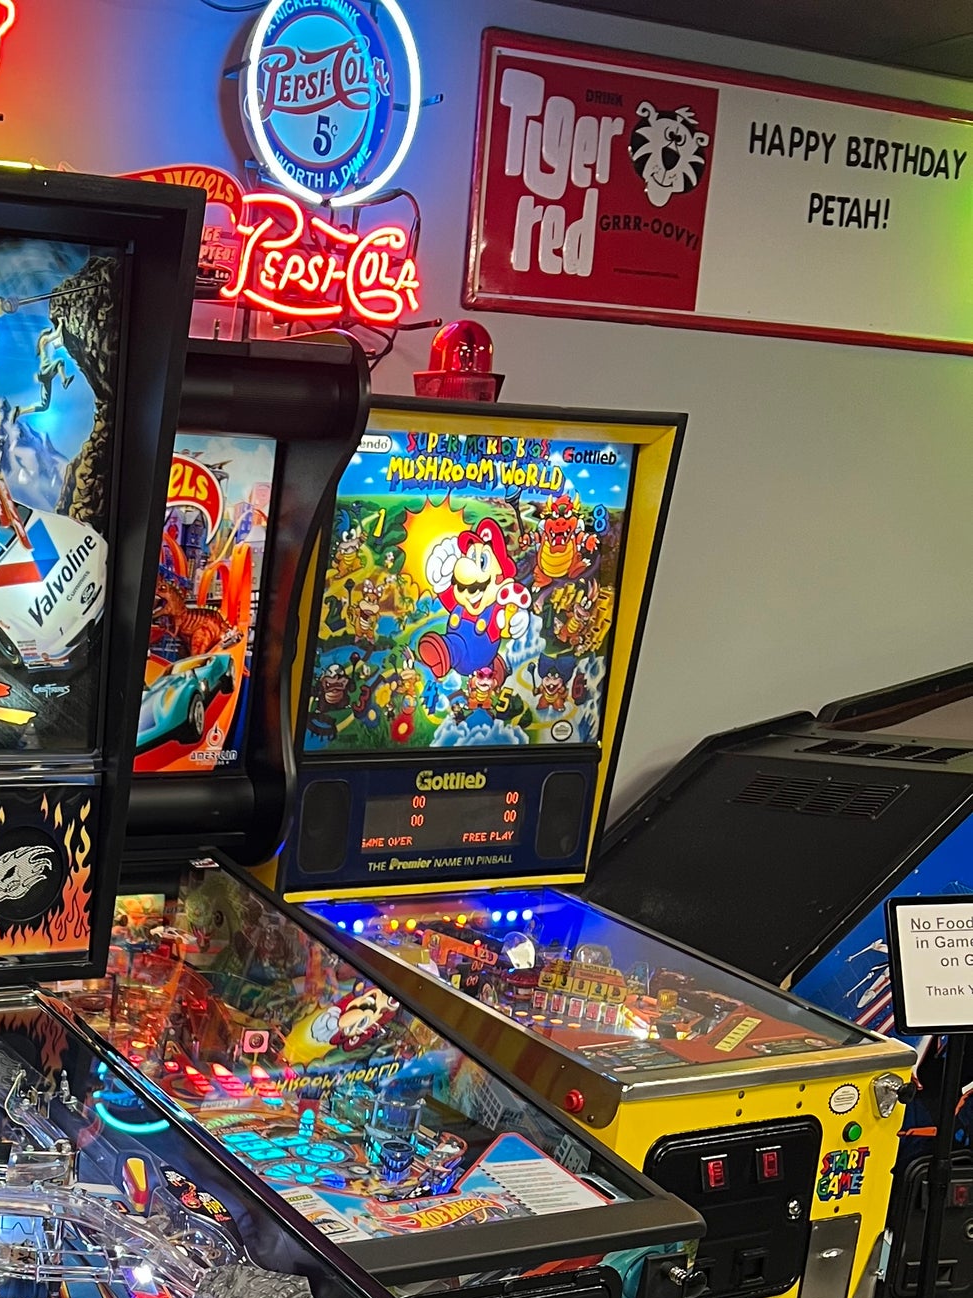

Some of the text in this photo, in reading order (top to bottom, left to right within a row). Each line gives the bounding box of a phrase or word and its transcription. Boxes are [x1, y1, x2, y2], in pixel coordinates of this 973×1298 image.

[500, 68, 625, 200] Tiger
[749, 121, 967, 180] HAPPY BIRTHDAY
[275, 146, 371, 188] WORTH A DIME
[808, 193, 890, 229] PETAH!
[511, 187, 599, 277] red
[599, 214, 699, 250] GRRR-OOVY!
[562, 446, 617, 466] Gottlieb
[386, 456, 565, 491] MUSHROOM WORLD
[28, 534, 97, 628] Valvoline
[416, 770, 486, 792] Gottlieb
[412, 795, 426, 809] 00
[505, 791, 519, 805] 00
[410, 814, 424, 827] 00
[503, 809, 517, 823] 00
[387, 836, 413, 847] OVER
[462, 830, 515, 843] FREE PLAY
[368, 861, 386, 872] THE
[433, 856, 462, 868] NAME
[463, 856, 475, 866] IN
[476, 854, 513, 865] PINBALL
[910, 918, 931, 930] No
[916, 937, 929, 949] in
[940, 957, 959, 967] on
[926, 985, 965, 996] Thank
[820, 1146, 870, 1175] START
[816, 1172, 864, 1201] GAME
